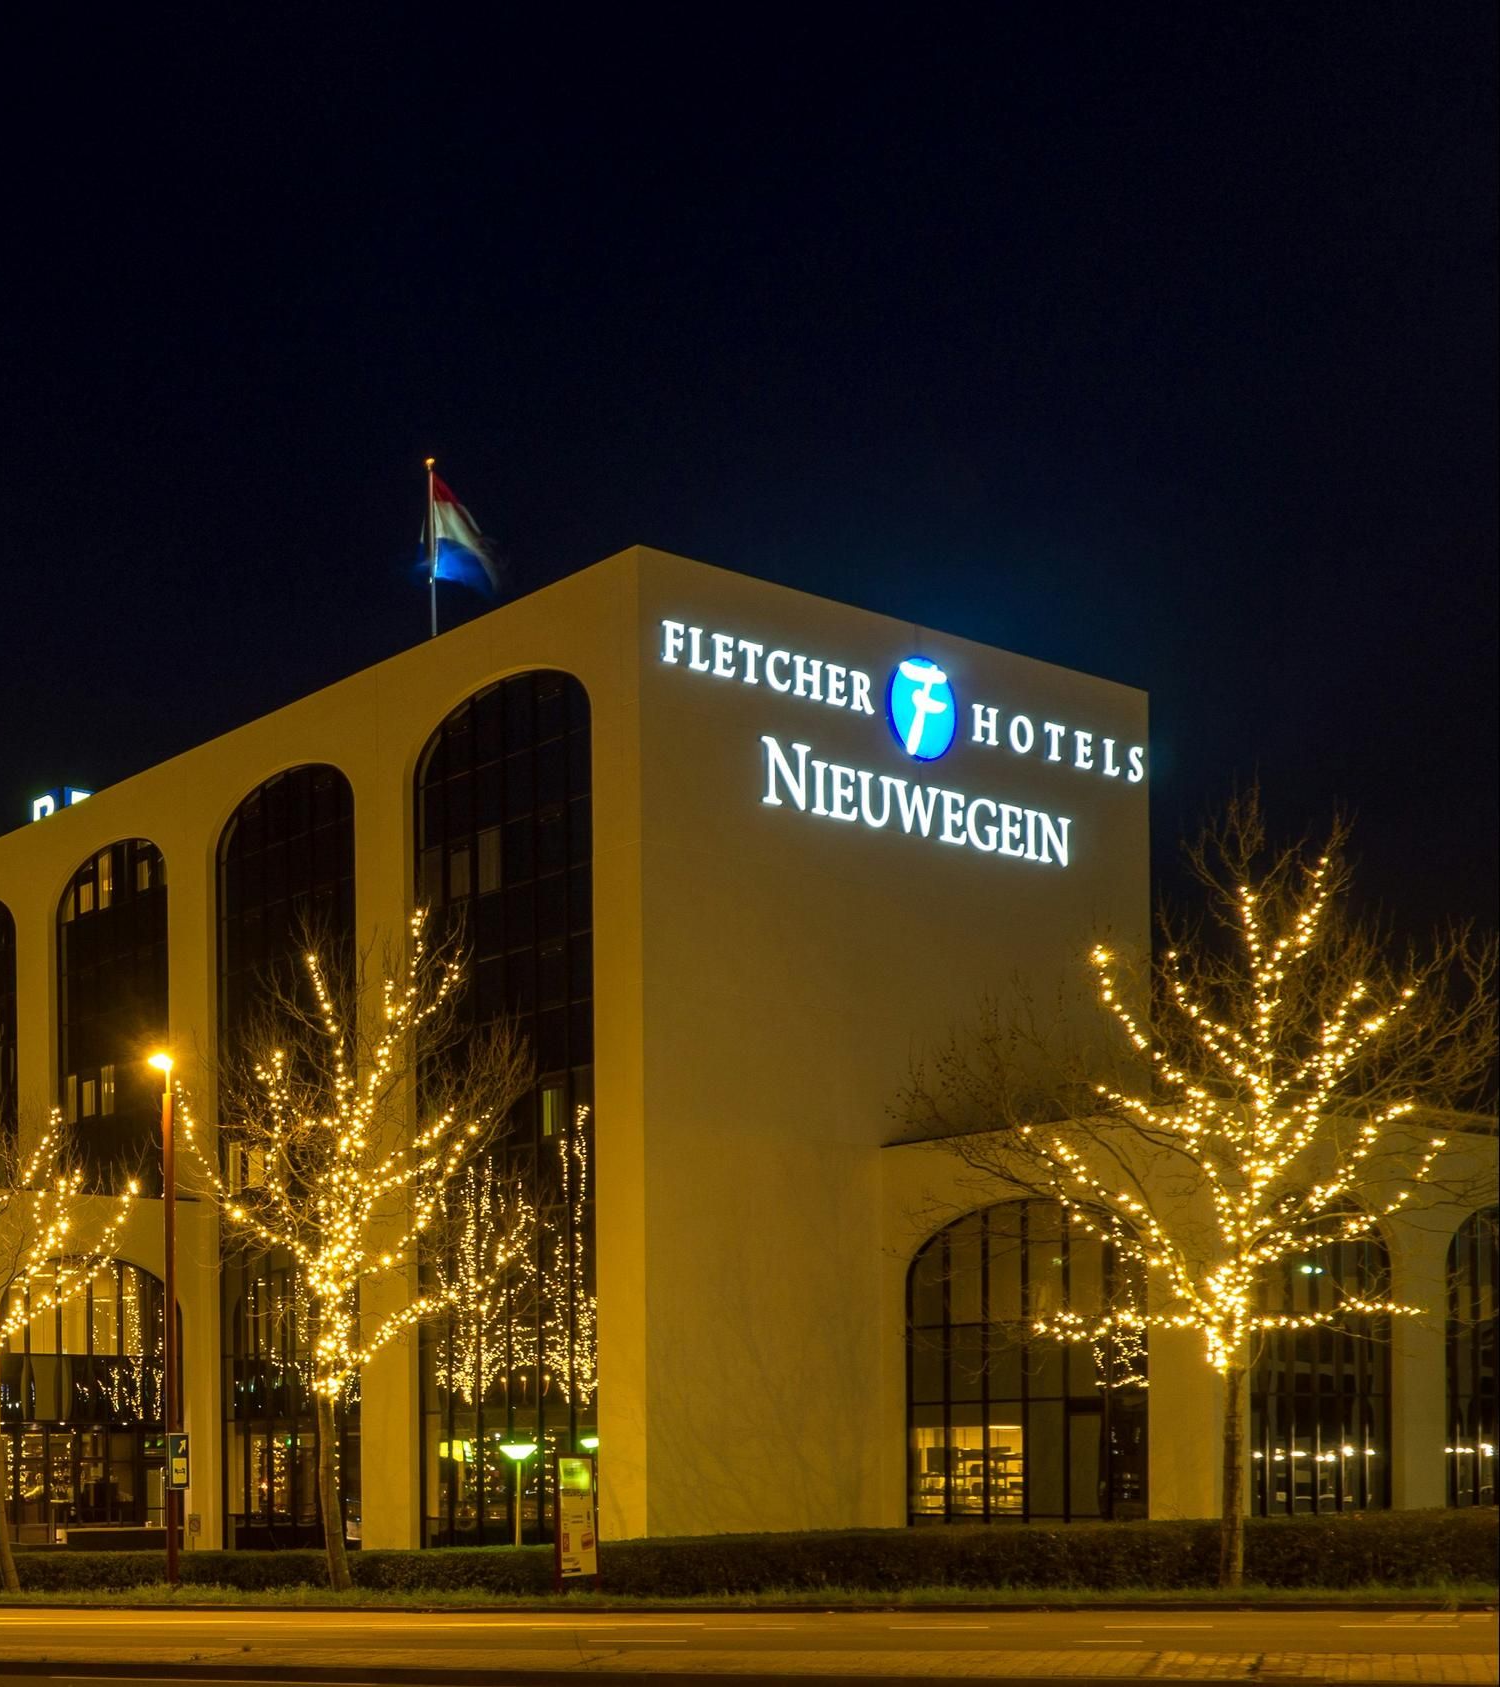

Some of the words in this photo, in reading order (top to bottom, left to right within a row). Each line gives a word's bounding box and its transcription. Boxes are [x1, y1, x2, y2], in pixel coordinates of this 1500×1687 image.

[661, 619, 875, 716] FLETCHER
[971, 703, 1145, 784] HOTELS
[760, 735, 1072, 868] NIEUWEGEIN
